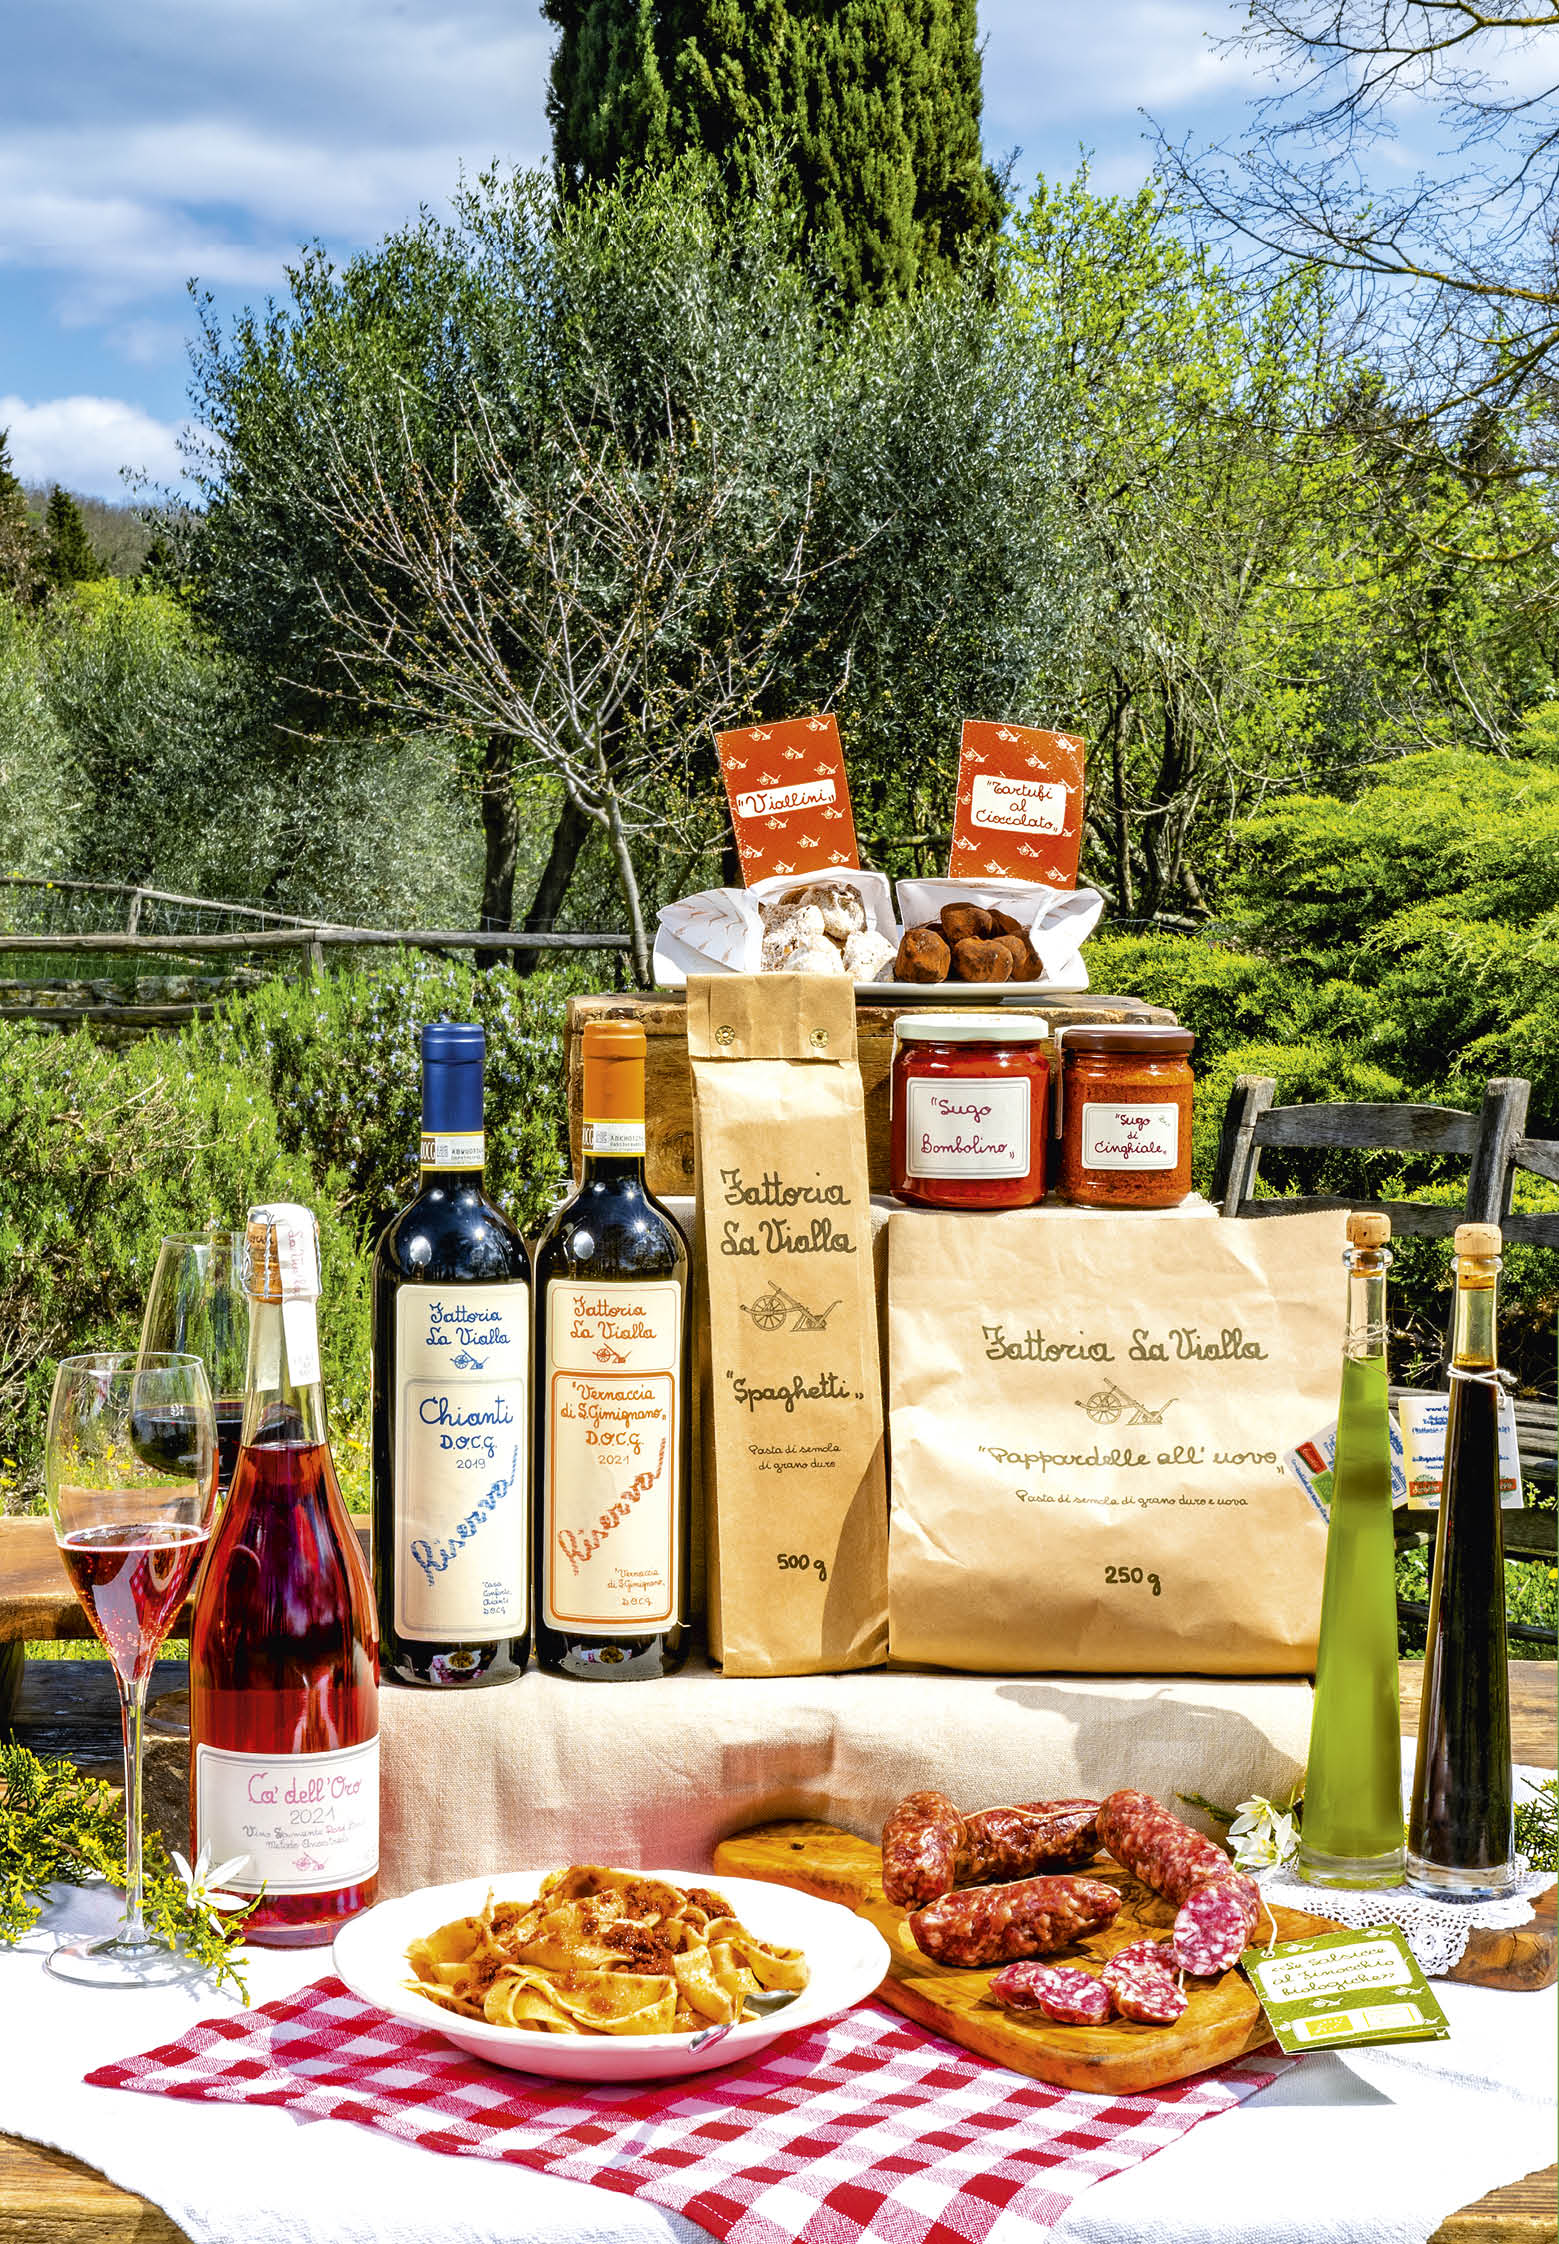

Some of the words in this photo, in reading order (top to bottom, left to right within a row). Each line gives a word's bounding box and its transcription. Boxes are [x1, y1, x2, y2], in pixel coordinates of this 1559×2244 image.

[1009, 798, 1027, 812] al
[1126, 1131, 1138, 1140] di
[720, 1168, 851, 1207] Fattoria
[758, 1217, 857, 1255] Vialla
[429, 1302, 502, 1324] Fattoria
[573, 1295, 647, 1317] Fattoria
[426, 1326, 451, 1346] La
[456, 1326, 511, 1346] Vialla
[570, 1320, 594, 1340] La
[598, 1320, 657, 1340] Vialla
[982, 1325, 1115, 1362] Fattoria
[1169, 1327, 1269, 1361] Vialla
[420, 1395, 514, 1427] Chianti
[561, 1402, 576, 1419] di
[748, 1444, 783, 1455] Pasta
[785, 1444, 797, 1454] di
[799, 1442, 841, 1454] semola
[456, 1458, 486, 1470] 2019
[598, 1454, 630, 1465] 2021
[759, 1460, 771, 1470] di
[773, 1462, 809, 1473] grano
[810, 1457, 836, 1468] duro
[1015, 1489, 1055, 1502] Pasta
[1058, 1494, 1070, 1503] di
[1074, 1495, 1120, 1505] semola
[1121, 1495, 1135, 1505] di
[1138, 1497, 1176, 1508] grano
[1178, 1494, 1207, 1505] duro
[1217, 1498, 1249, 1506] uova
[777, 1553, 810, 1570] 500
[813, 1556, 828, 1581] g
[1104, 1565, 1144, 1584] 250
[1147, 1571, 1161, 1596] g
[284, 1775, 363, 1804] dell'Oro
[290, 1807, 336, 1825] 2021
[242, 1825, 271, 1838] Vino
